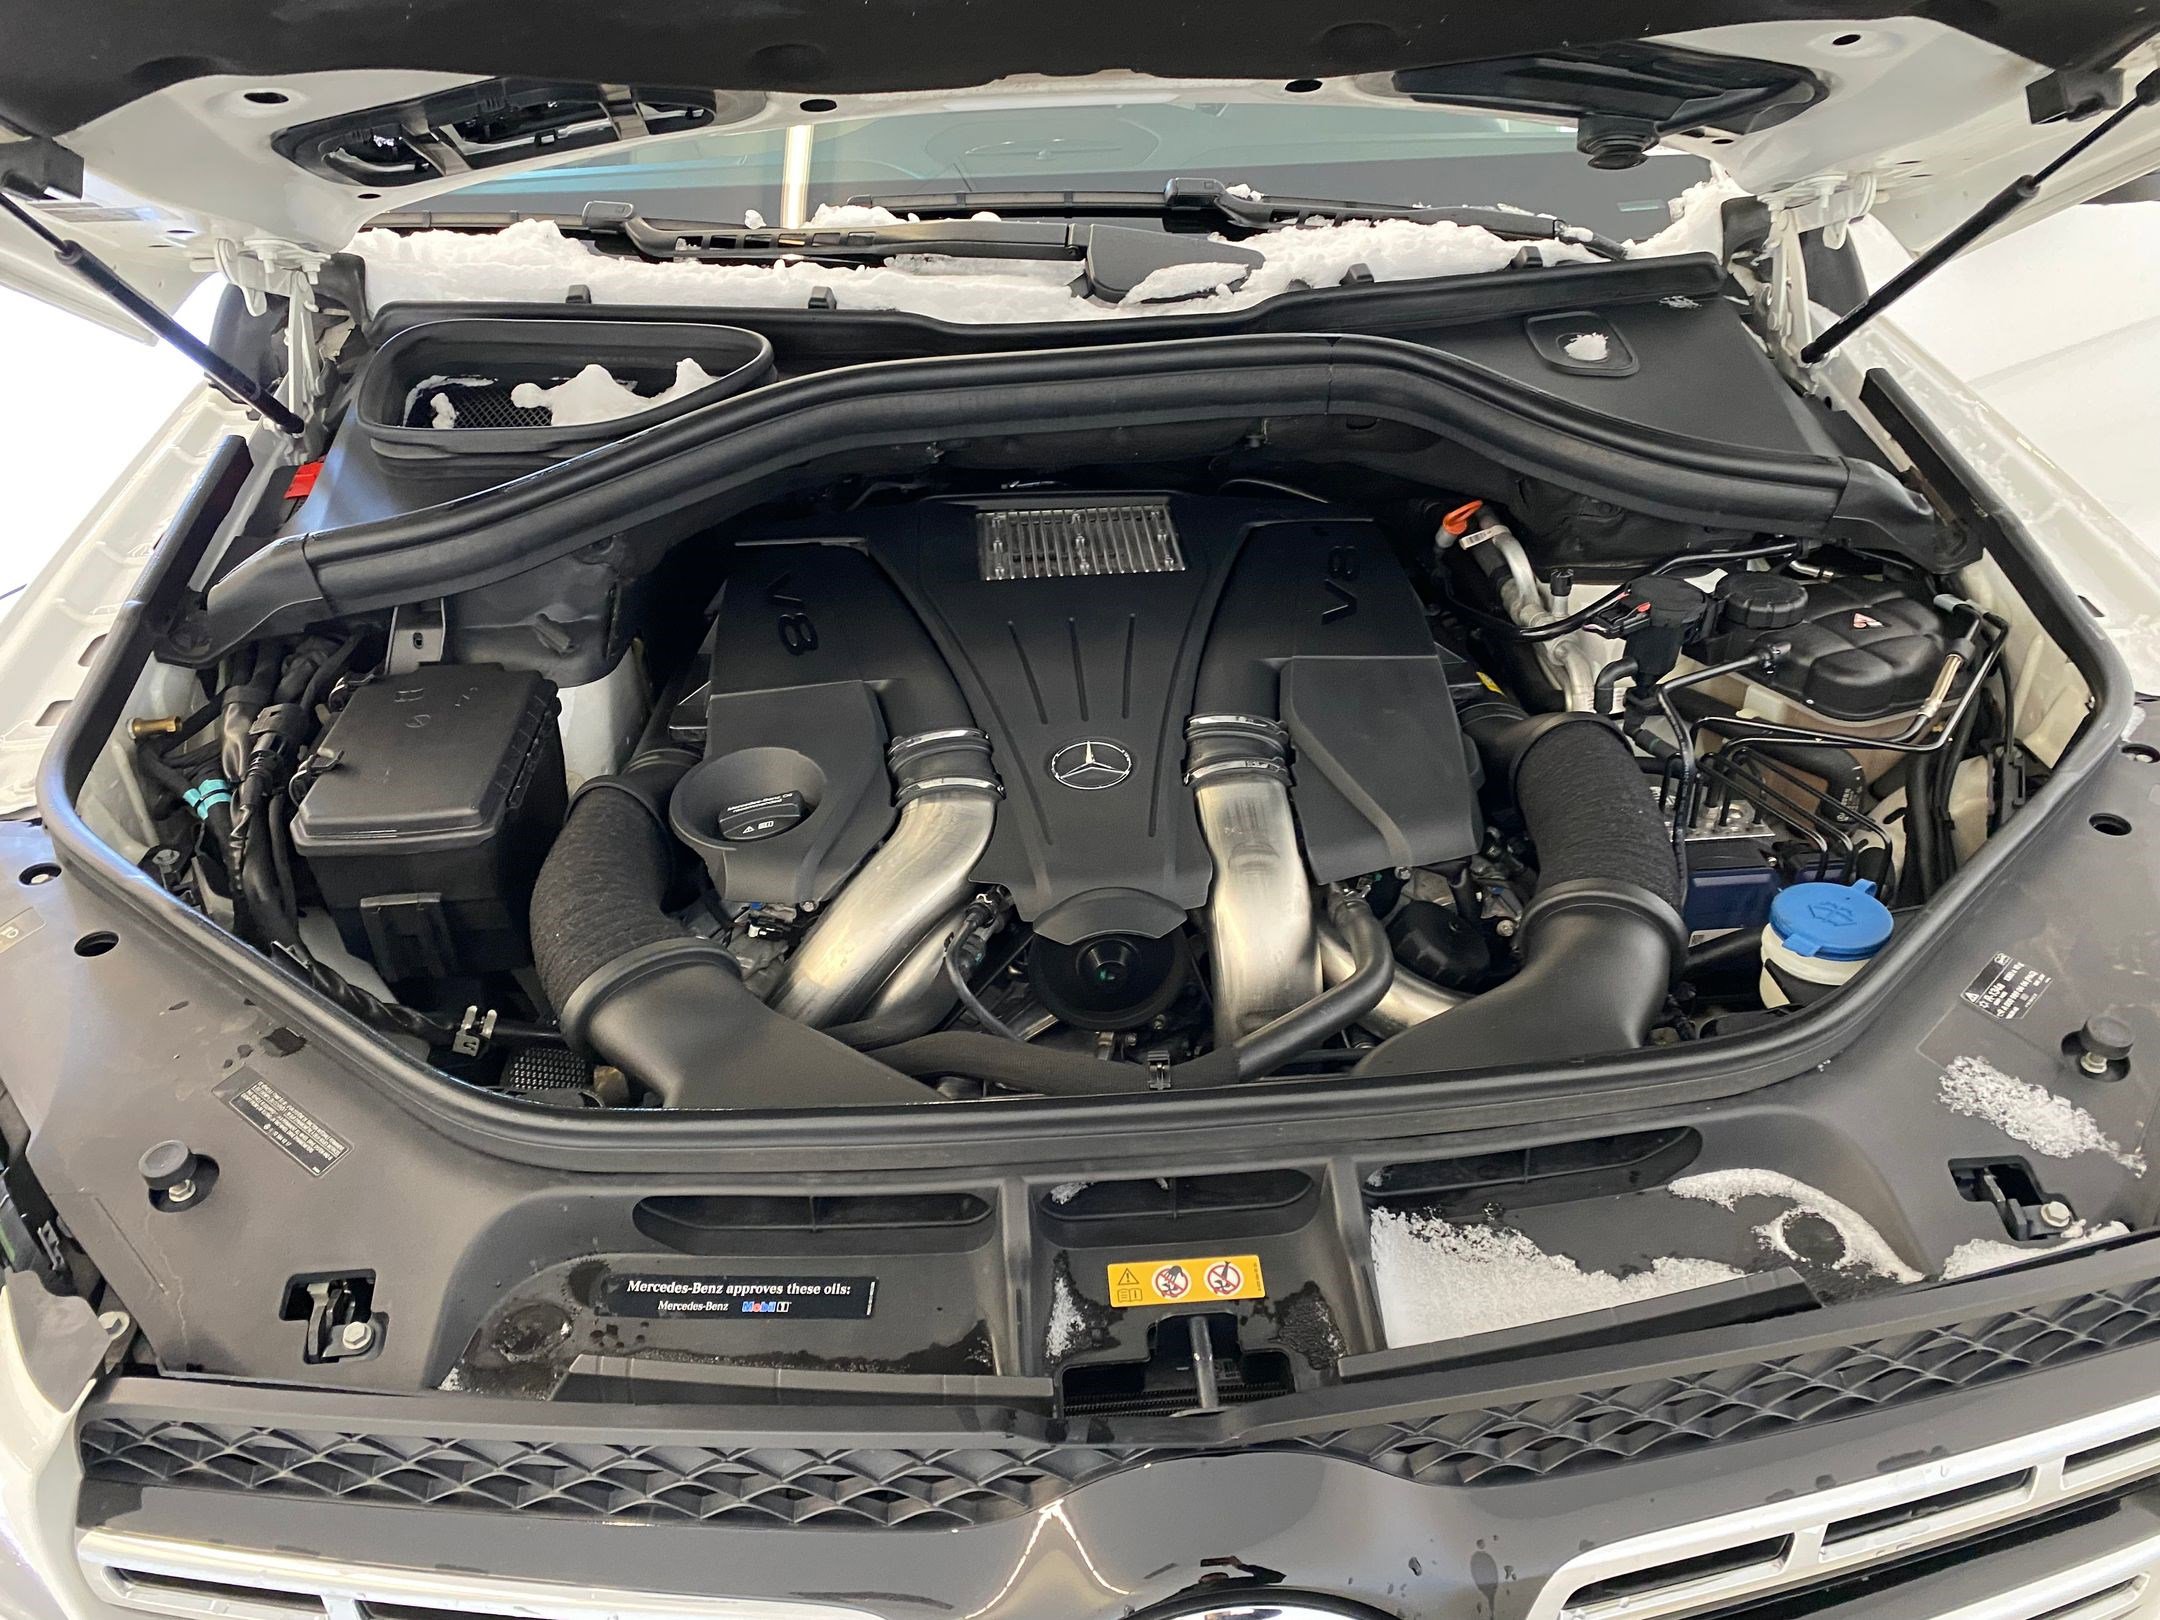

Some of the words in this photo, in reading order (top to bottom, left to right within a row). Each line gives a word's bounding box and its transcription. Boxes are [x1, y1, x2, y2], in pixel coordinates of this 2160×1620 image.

[1320, 546, 1360, 626] V8
[766, 570, 819, 656] V8
[626, 1280, 723, 1295] Mercedes-Benz
[726, 1284, 783, 1297] approves
[786, 1283, 821, 1295] these
[823, 1282, 851, 1295] oils:
[657, 1300, 728, 1311] Mercedes-Benz
[741, 1301, 776, 1312] Mobil
